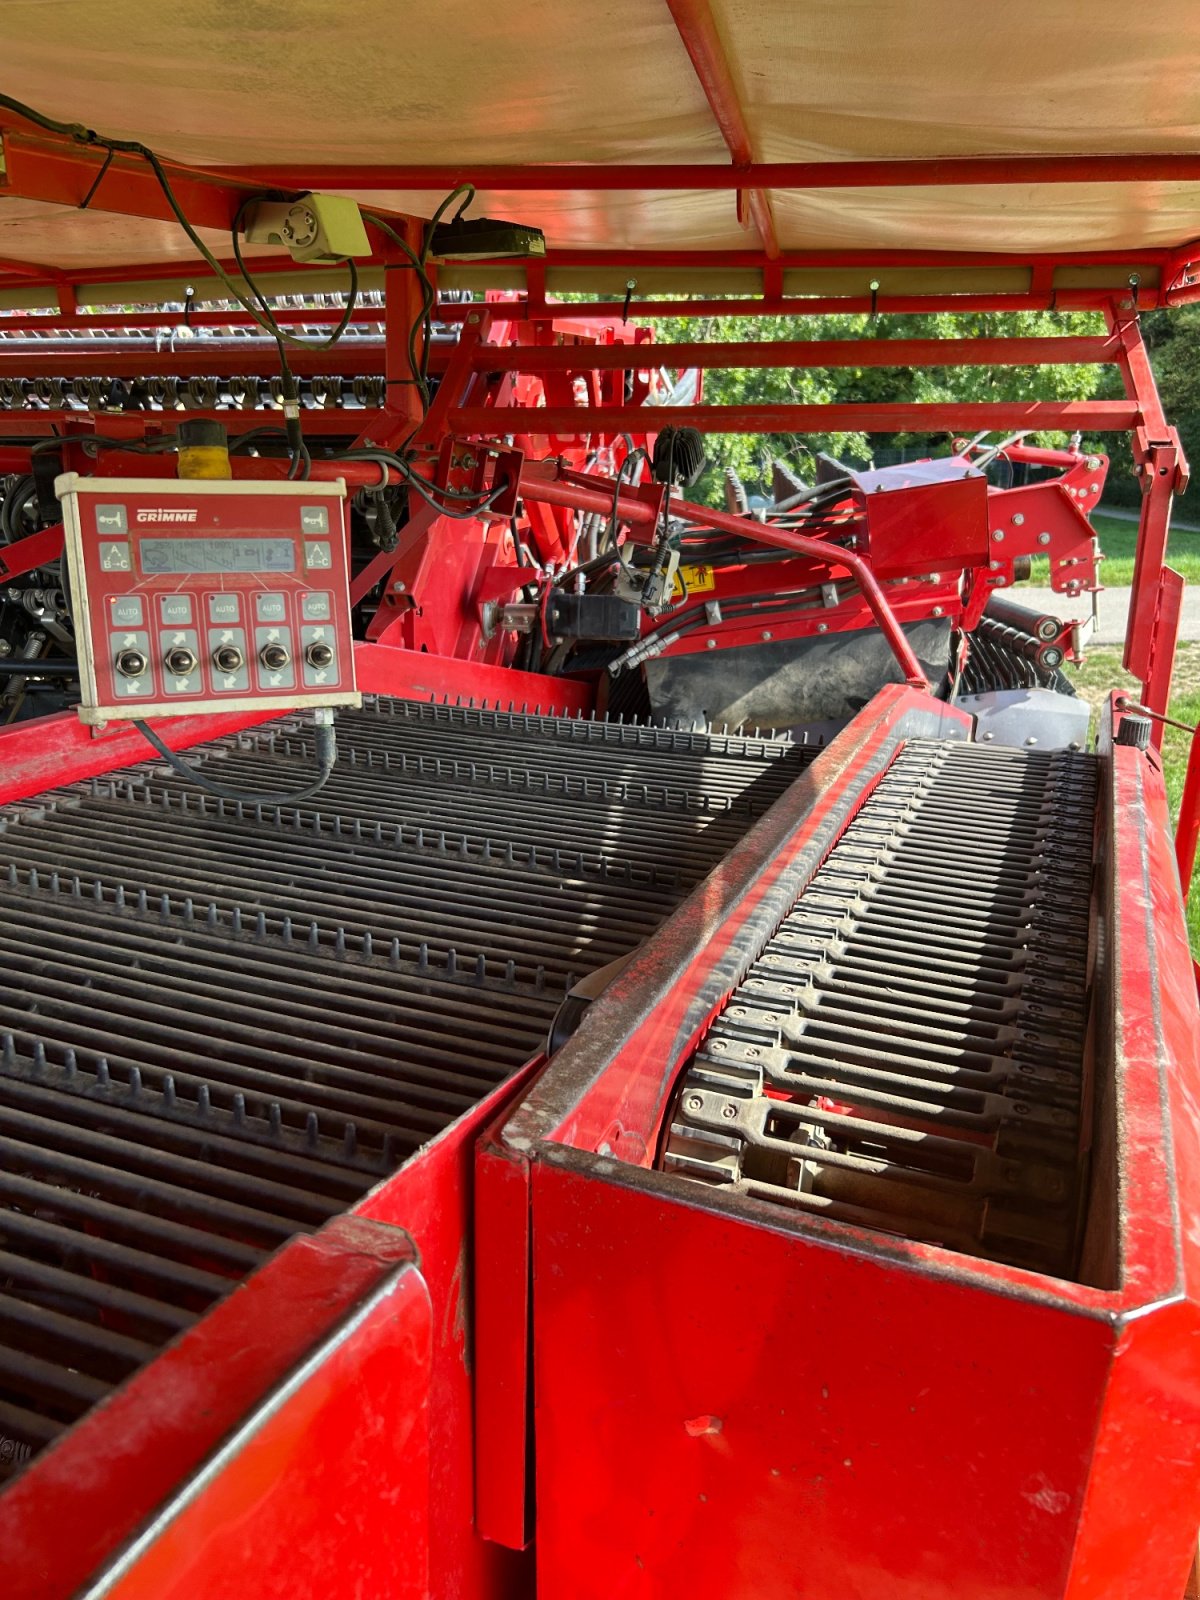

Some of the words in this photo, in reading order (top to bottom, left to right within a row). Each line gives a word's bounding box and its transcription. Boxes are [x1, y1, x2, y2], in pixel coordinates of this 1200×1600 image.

[111, 544, 119, 554] A
[313, 543, 321, 553] A
[167, 606, 187, 614] AUTO
[215, 605, 236, 613] AUTO
[262, 604, 282, 612] AUTO
[307, 603, 327, 611] AUTO
[117, 608, 139, 616] AUTO
